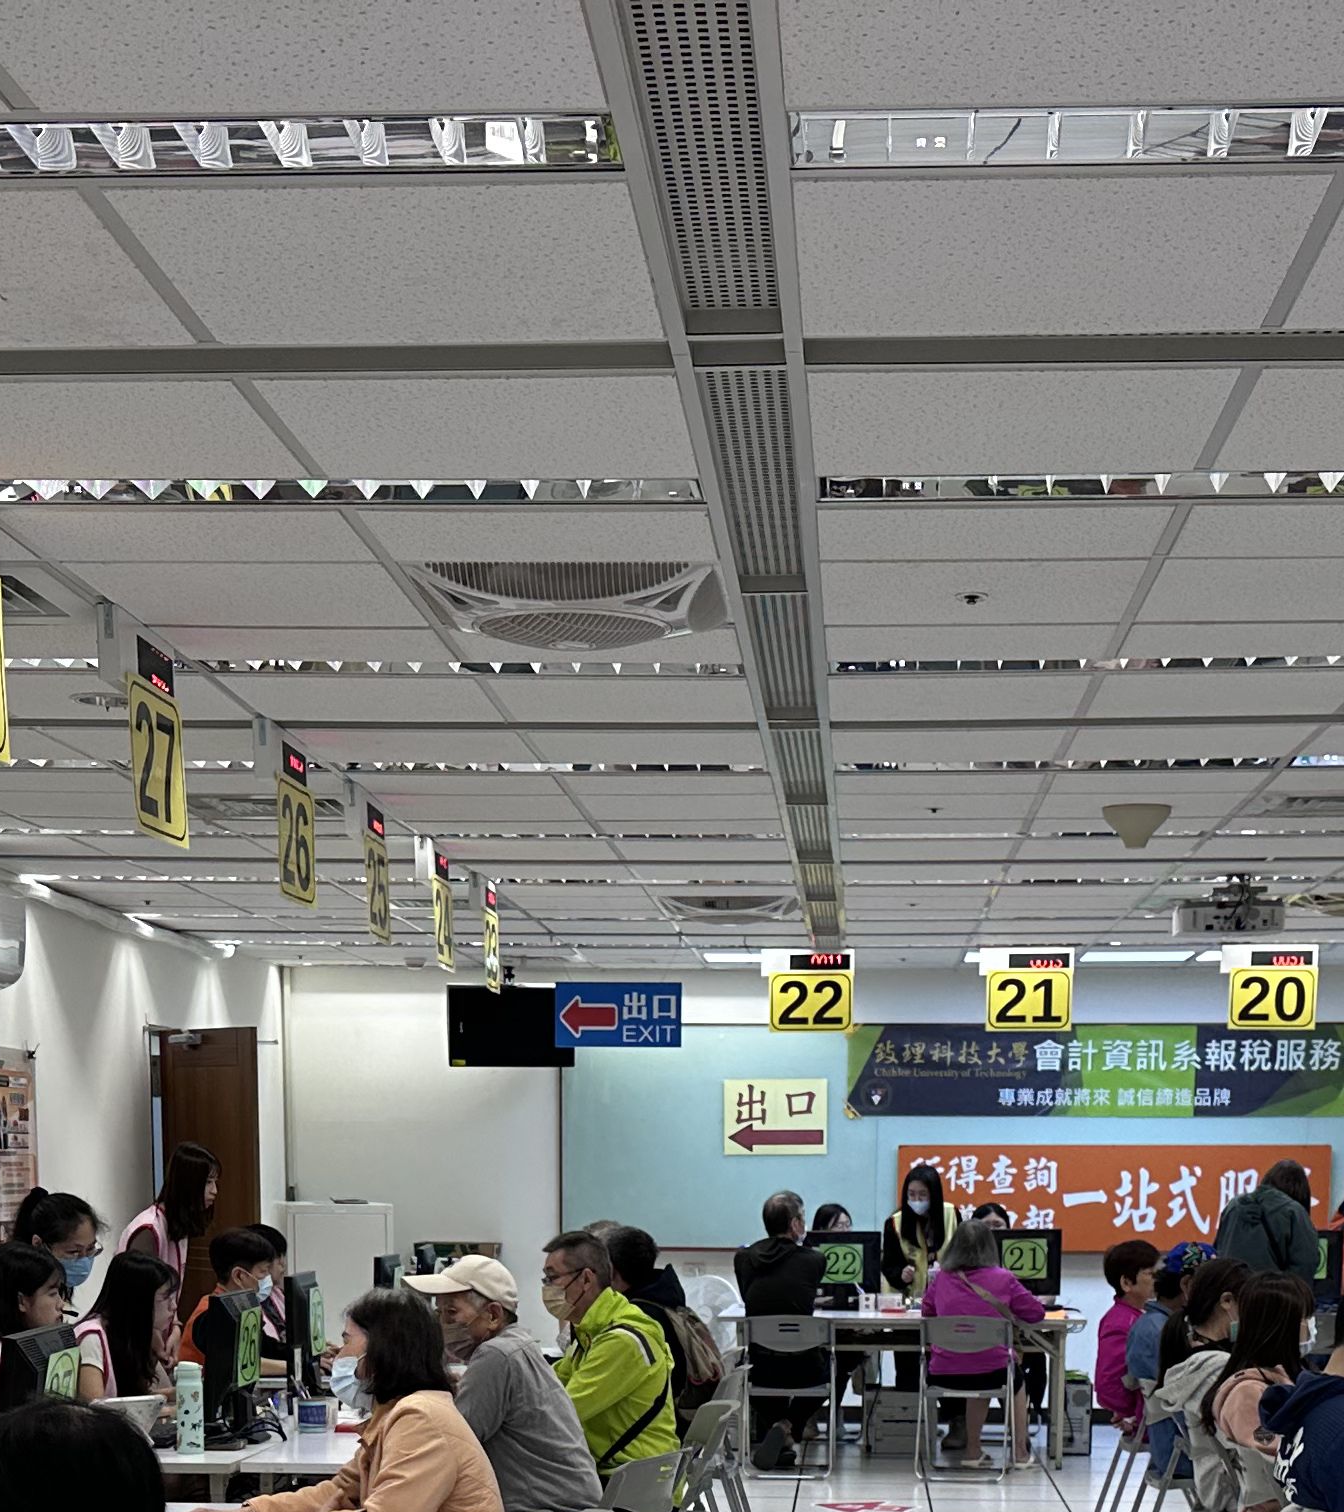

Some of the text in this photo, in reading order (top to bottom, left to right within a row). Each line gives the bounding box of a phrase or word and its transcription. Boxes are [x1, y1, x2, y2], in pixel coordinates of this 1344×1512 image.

[136, 701, 174, 824] 27
[282, 794, 310, 892] 26
[368, 848, 387, 930] 25
[436, 889, 452, 959] 24
[622, 992, 677, 1021] 出口
[778, 980, 843, 1025] 22
[995, 978, 1062, 1023] 21
[1238, 976, 1306, 1021] 20
[622, 1025, 677, 1043] EXIT
[735, 1084, 816, 1125] 出口
[998, 1088, 1232, 1107] 專業成就將來 誠信締造品牌
[826, 1253, 856, 1276] 22
[1009, 1248, 1042, 1272] 21
[241, 1324, 257, 1369] 26
